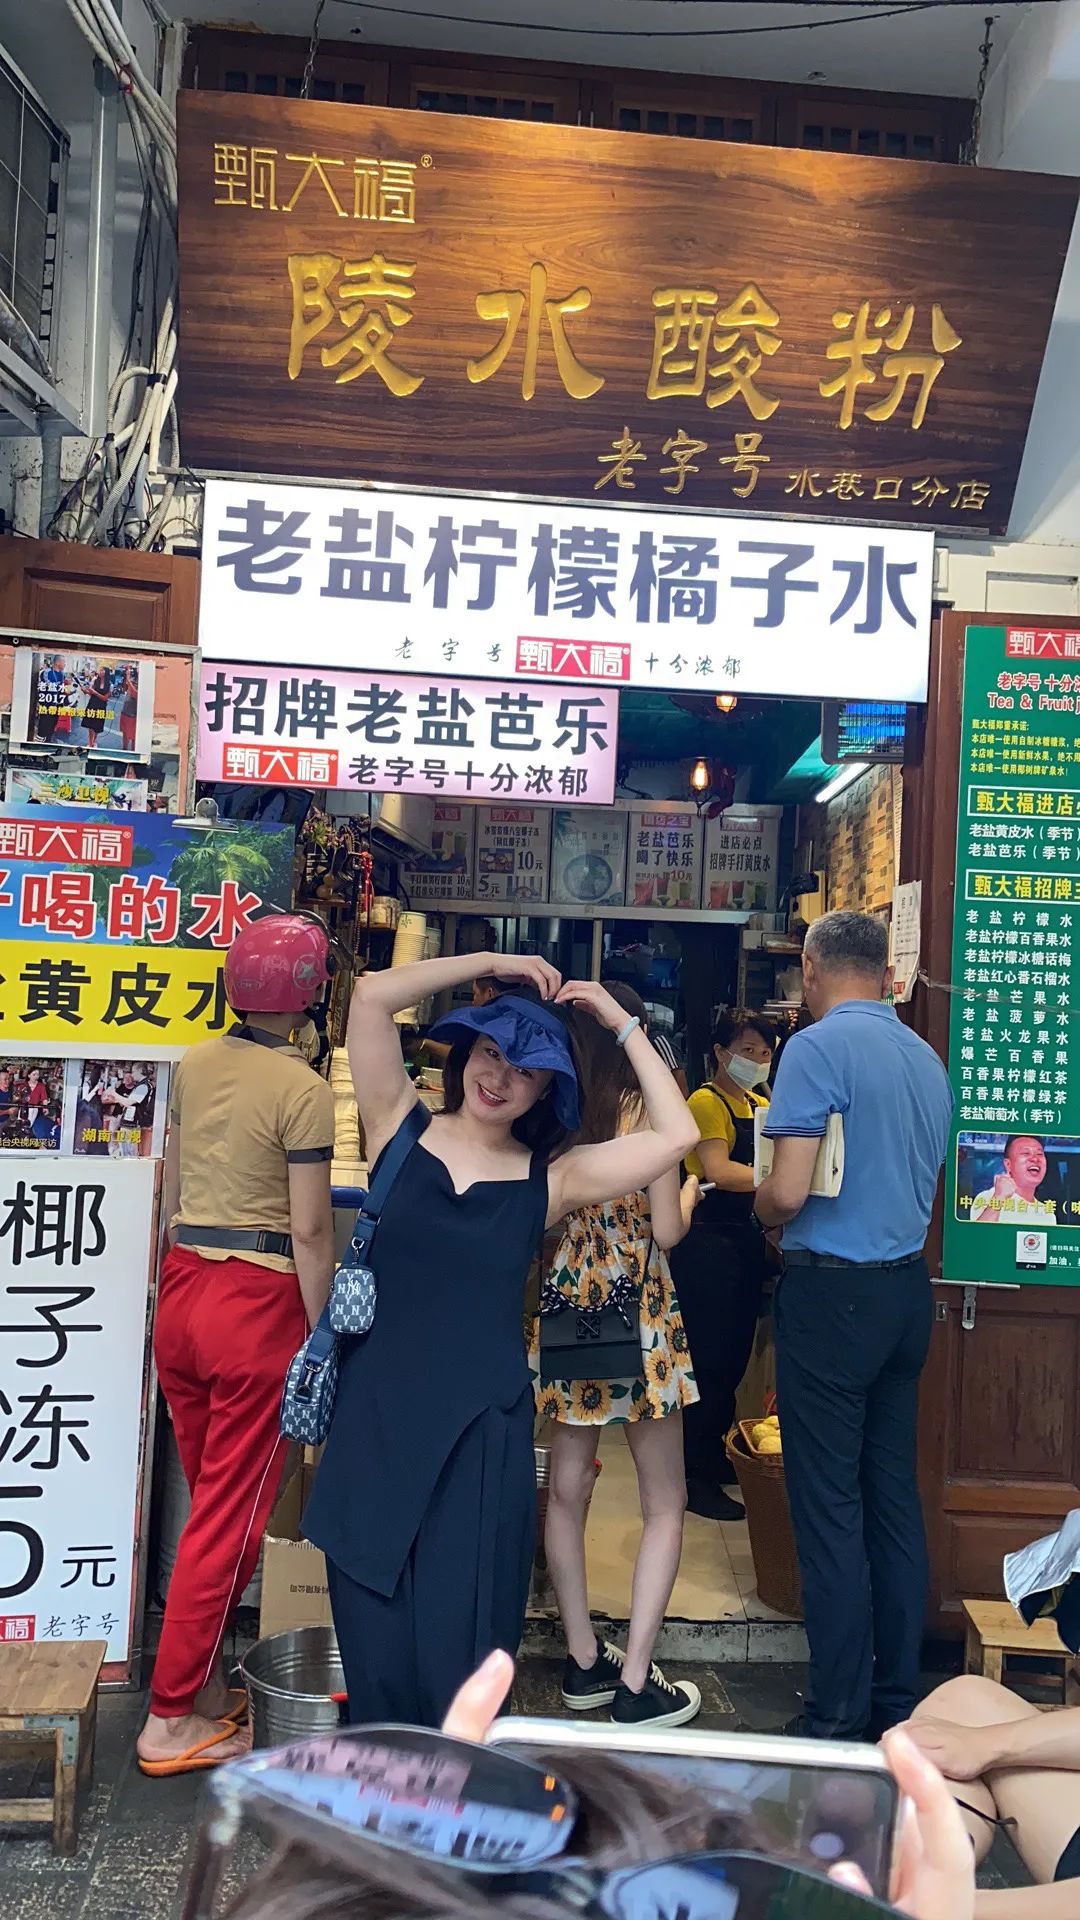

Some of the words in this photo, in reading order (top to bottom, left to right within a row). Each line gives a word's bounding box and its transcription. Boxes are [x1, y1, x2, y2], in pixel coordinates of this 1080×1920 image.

[214, 143, 417, 223] 甄大福
[288, 251, 963, 430] 陵水酸粉
[593, 426, 771, 498] 老字号
[784, 466, 991, 511] 水巷口分店
[216, 499, 918, 635] 老盐柠檬橘子水
[394, 635, 502, 663] 老字号
[519, 639, 623, 677] 甄大福
[644, 649, 742, 679] 十分浓郁
[997, 671, 1041, 691] 老字号
[38, 693, 66, 704] 2017
[987, 692, 1014, 709] Tea
[1020, 693, 1033, 710] &
[1038, 694, 1074, 711] Fruit
[205, 672, 610, 757] 招牌老盐芭乐
[225, 747, 330, 783] 甄大福
[348, 754, 588, 797] 老字号十分浓郁
[976, 791, 1080, 816] 甄大福进店
[637, 831, 694, 848] 老盐芭乐
[720, 835, 762, 850] 进店必点
[636, 850, 693, 867] 喝了快乐
[709, 853, 771, 872] 招牌手打黄皮水
[966, 909, 1073, 928] 老盐柠檬水
[965, 929, 1072, 948] 老盐柠檬百香果水
[964, 948, 1072, 967] 老盐柠檬冰糖话梅
[963, 968, 1070, 987] 老盐红心番石榴水
[0, 958, 243, 1031] 黄皮水
[963, 987, 1070, 1006] 老盐芒果水
[962, 1007, 1069, 1026] 老盐菠萝水
[962, 1026, 1069, 1046] 老盐火龙果水
[961, 1046, 1068, 1065] 爆芒百香果
[961, 1066, 1068, 1085] 百香果柠檬红茶
[960, 1086, 1067, 1105] 百香果柠檬绿茶
[0, 1137, 57, 1148] 台央视网采访
[82, 1128, 142, 1144] 湖南卫视
[1048, 1256, 1080, 1267] 加油，
[0, 1181, 106, 1470] 椰子冻
[42, 1612, 119, 1638] 老字号
